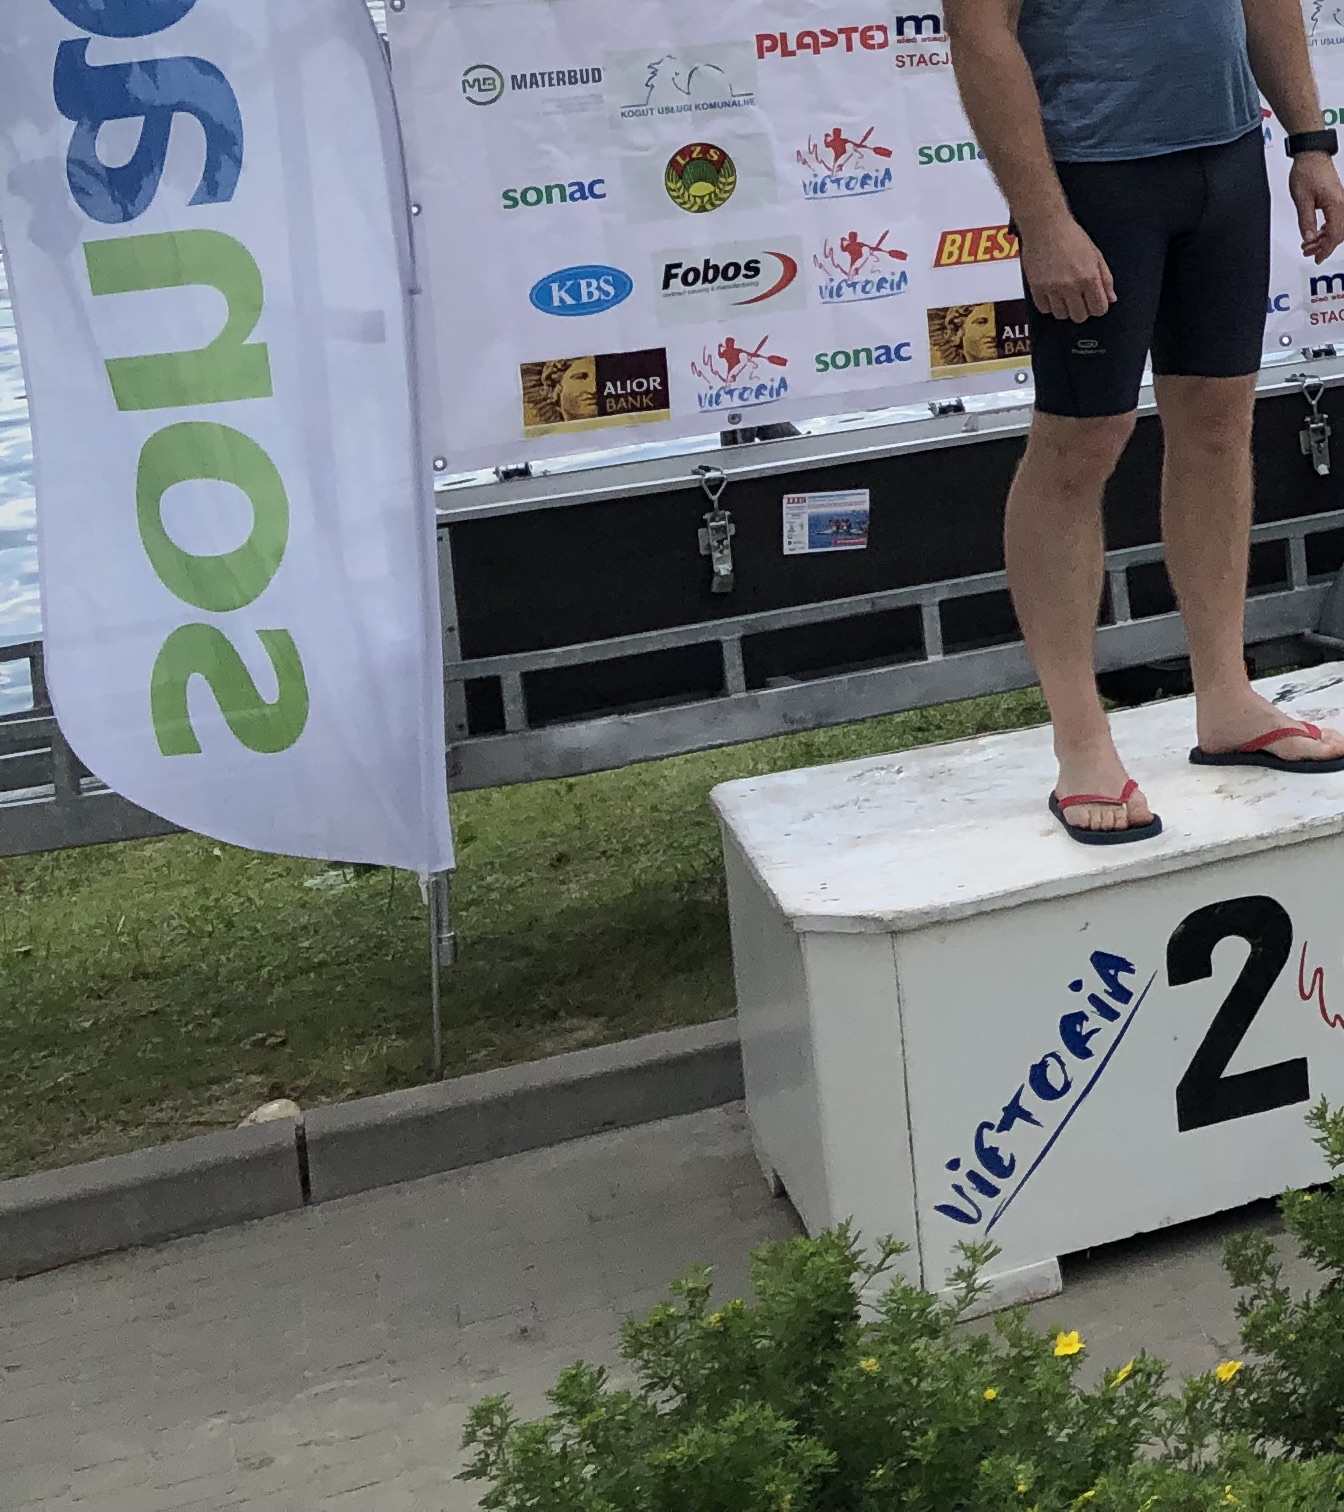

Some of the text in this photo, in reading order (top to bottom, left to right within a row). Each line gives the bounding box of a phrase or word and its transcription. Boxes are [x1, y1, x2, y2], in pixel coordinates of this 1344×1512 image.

[895, 53, 950, 68] STACJ
[511, 68, 602, 90] MATERBUD
[620, 109, 654, 119] KOGUT
[675, 145, 720, 167] LZS
[918, 141, 985, 165] son
[502, 179, 606, 209] sonac
[940, 227, 1019, 265] BLES
[662, 258, 761, 290] Fobos
[550, 276, 615, 307] KBS
[1002, 325, 1029, 339] ALI
[815, 342, 912, 372] sonac
[603, 377, 662, 396] ALIOR
[606, 393, 654, 413] BANK
[1166, 895, 1310, 1132] 2
